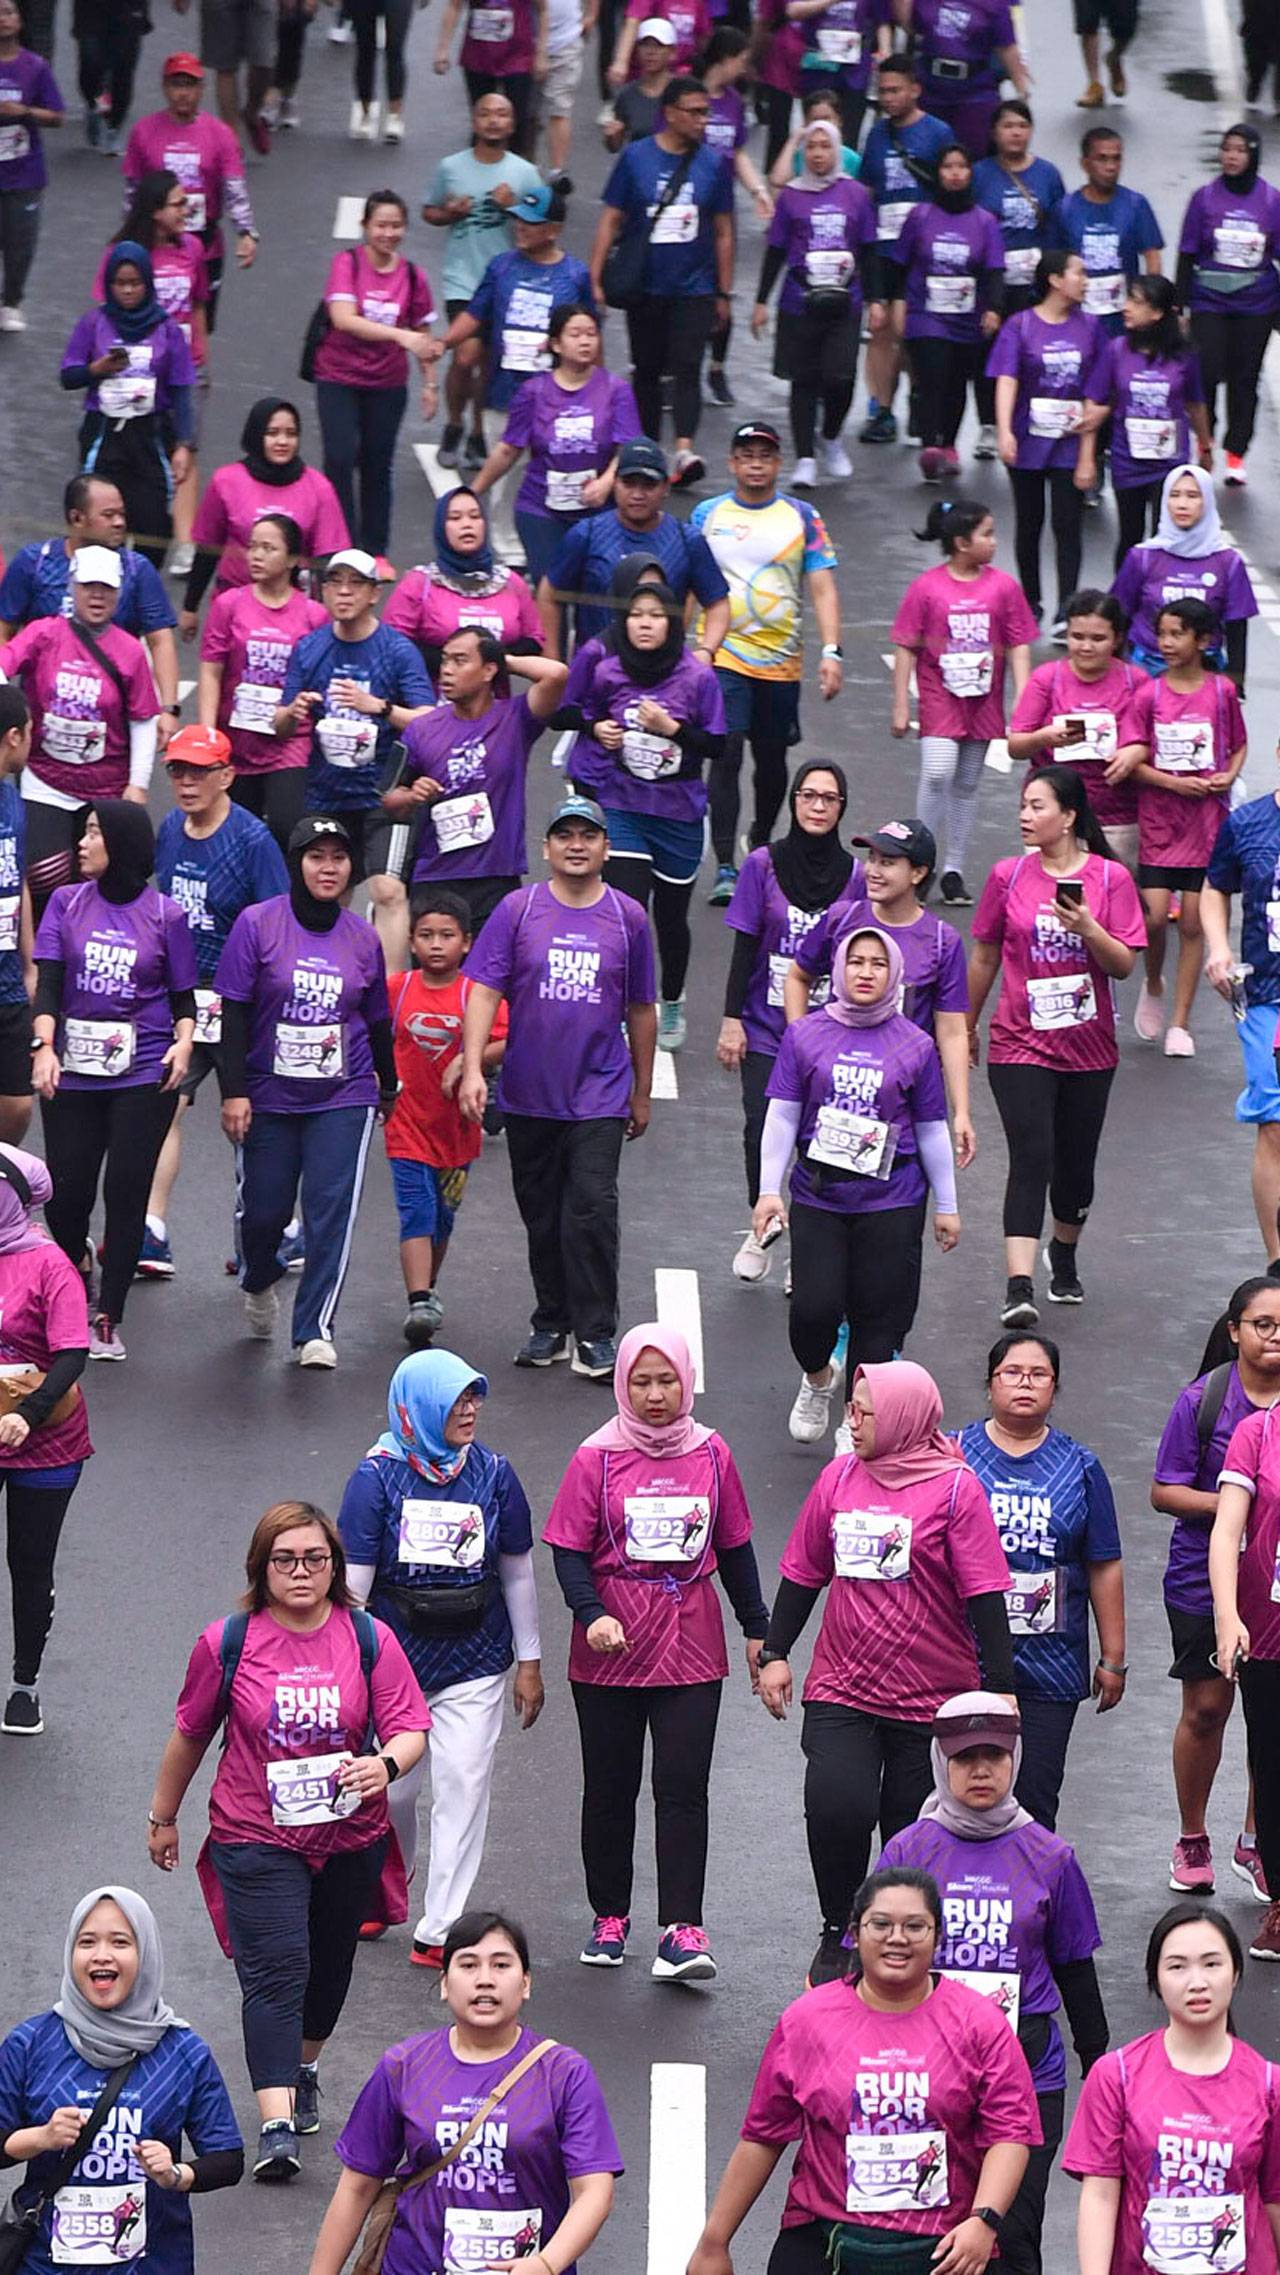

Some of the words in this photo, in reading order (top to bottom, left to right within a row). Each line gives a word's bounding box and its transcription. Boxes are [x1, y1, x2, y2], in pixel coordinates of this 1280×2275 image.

[246, 640, 293, 660] RUN
[171, 876, 207, 898] RUN
[188, 912, 215, 930] PE
[1038, 930, 1083, 948] FOR
[85, 942, 137, 966] RUN
[549, 949, 600, 970] RUN
[1031, 946, 1088, 963] HOPE
[86, 960, 131, 981] FOR
[550, 968, 597, 988] FOR
[77, 972, 136, 999] HOPE
[293, 970, 342, 994] RUN
[539, 982, 602, 1003] HOPE
[294, 988, 338, 1010] FOR
[282, 1002, 341, 1024] HOPE
[832, 1064, 884, 1088] RUN
[834, 1082, 877, 1101] FOR
[991, 1493, 1050, 1518] RUN
[633, 1521, 685, 1537] 2792
[998, 1515, 1048, 1537] FOR
[836, 1537, 878, 1554] 2791
[1002, 1533, 1056, 1557] OPE
[275, 1686, 341, 1709] RUN
[279, 1708, 338, 1729] FOR
[268, 1728, 349, 1747] HOPE
[278, 1781, 330, 1800] 2451
[943, 1899, 1012, 1924] RUN
[946, 1921, 1008, 1945] FOR
[934, 1945, 1018, 1968] HOPE
[856, 2072, 929, 2098] RUN
[861, 2097, 927, 2121] FOR
[93, 2131, 138, 2158] OR
[436, 2121, 508, 2148] RUN
[1158, 2134, 1233, 2168] RUN
[436, 2165, 516, 2194] HOPE
[855, 2160, 918, 2183] 2534
[1161, 2161, 1226, 2193] FOR
[60, 2214, 115, 2235] 2558
[1151, 2225, 1213, 2247] 2565
[452, 2239, 515, 2260] 2556
